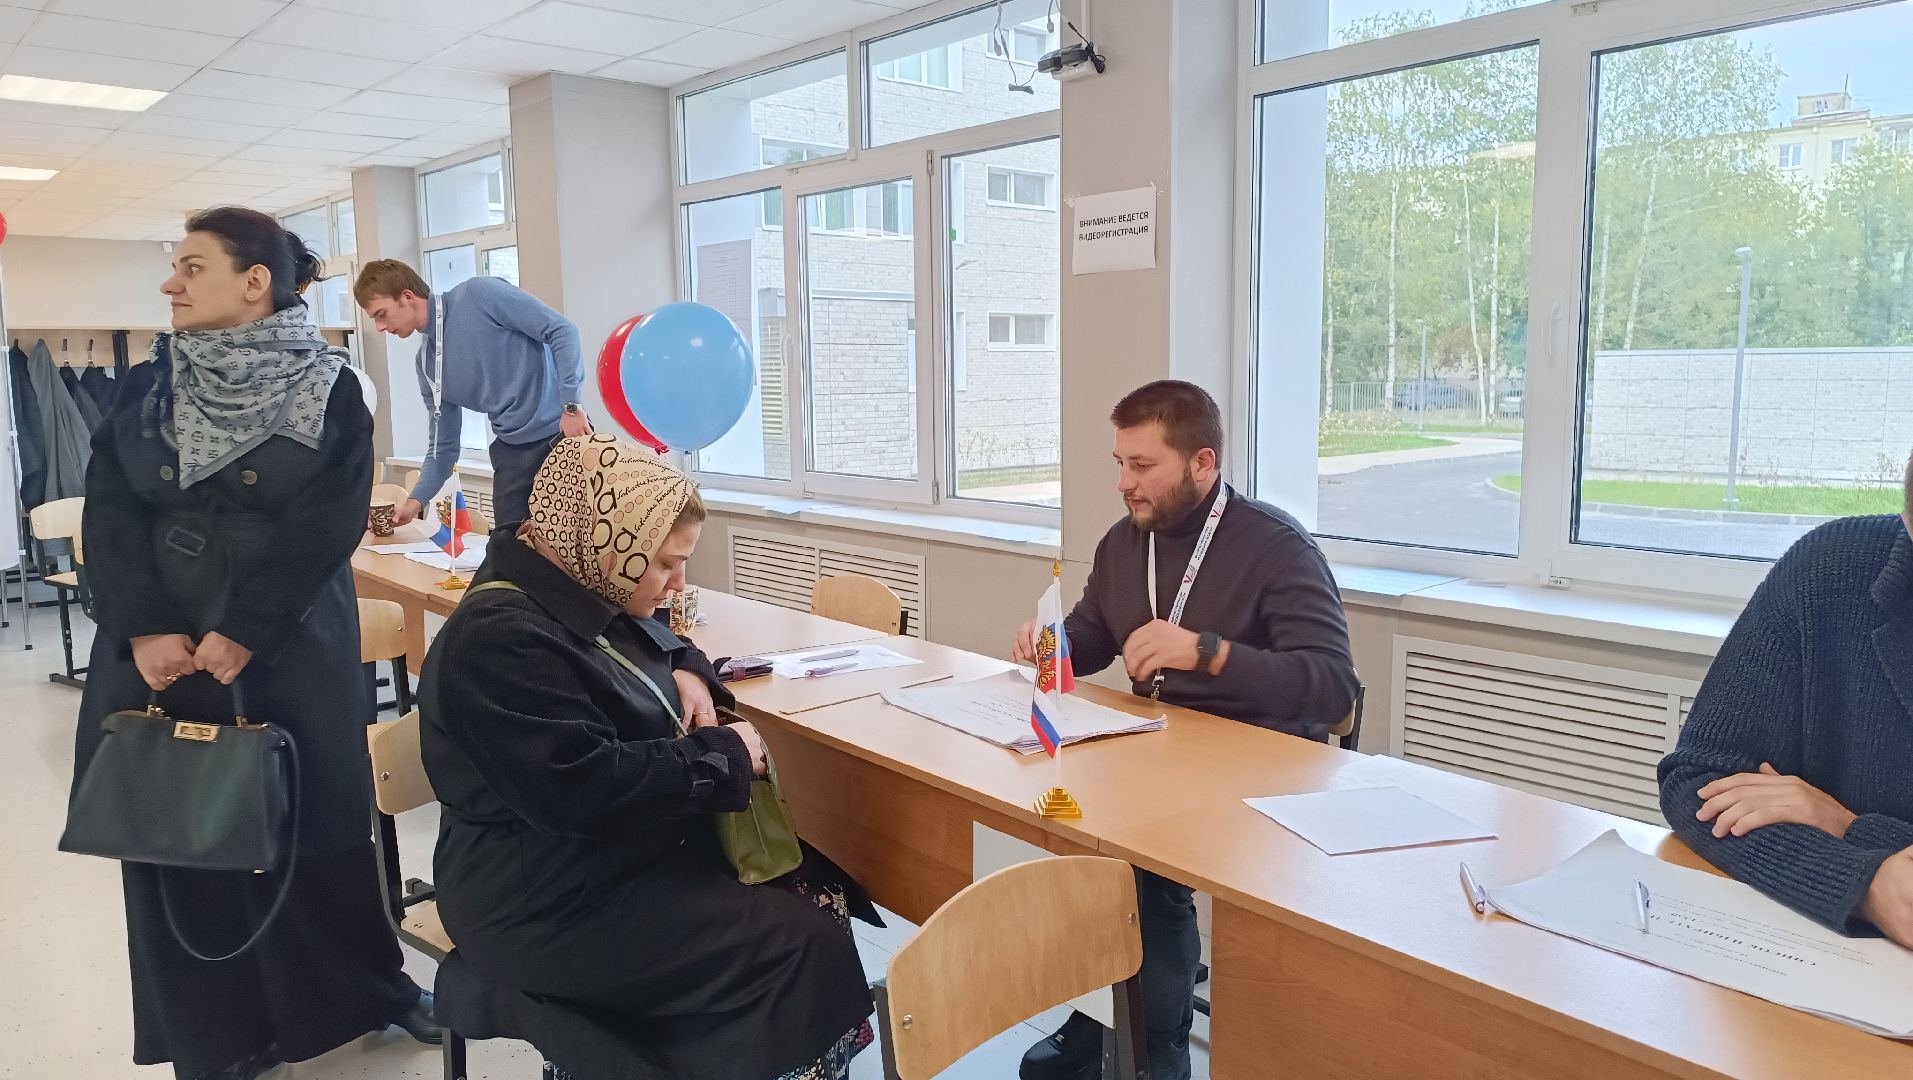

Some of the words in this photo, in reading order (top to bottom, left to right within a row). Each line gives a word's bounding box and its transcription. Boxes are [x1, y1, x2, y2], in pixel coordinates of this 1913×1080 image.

[1079, 216, 1117, 228] ВНИМАНИЕ
[1118, 211, 1149, 223] ВЕДЕТСЯ
[1078, 225, 1149, 241] ВИДЕОРЕГИСТРАЦИЯ
